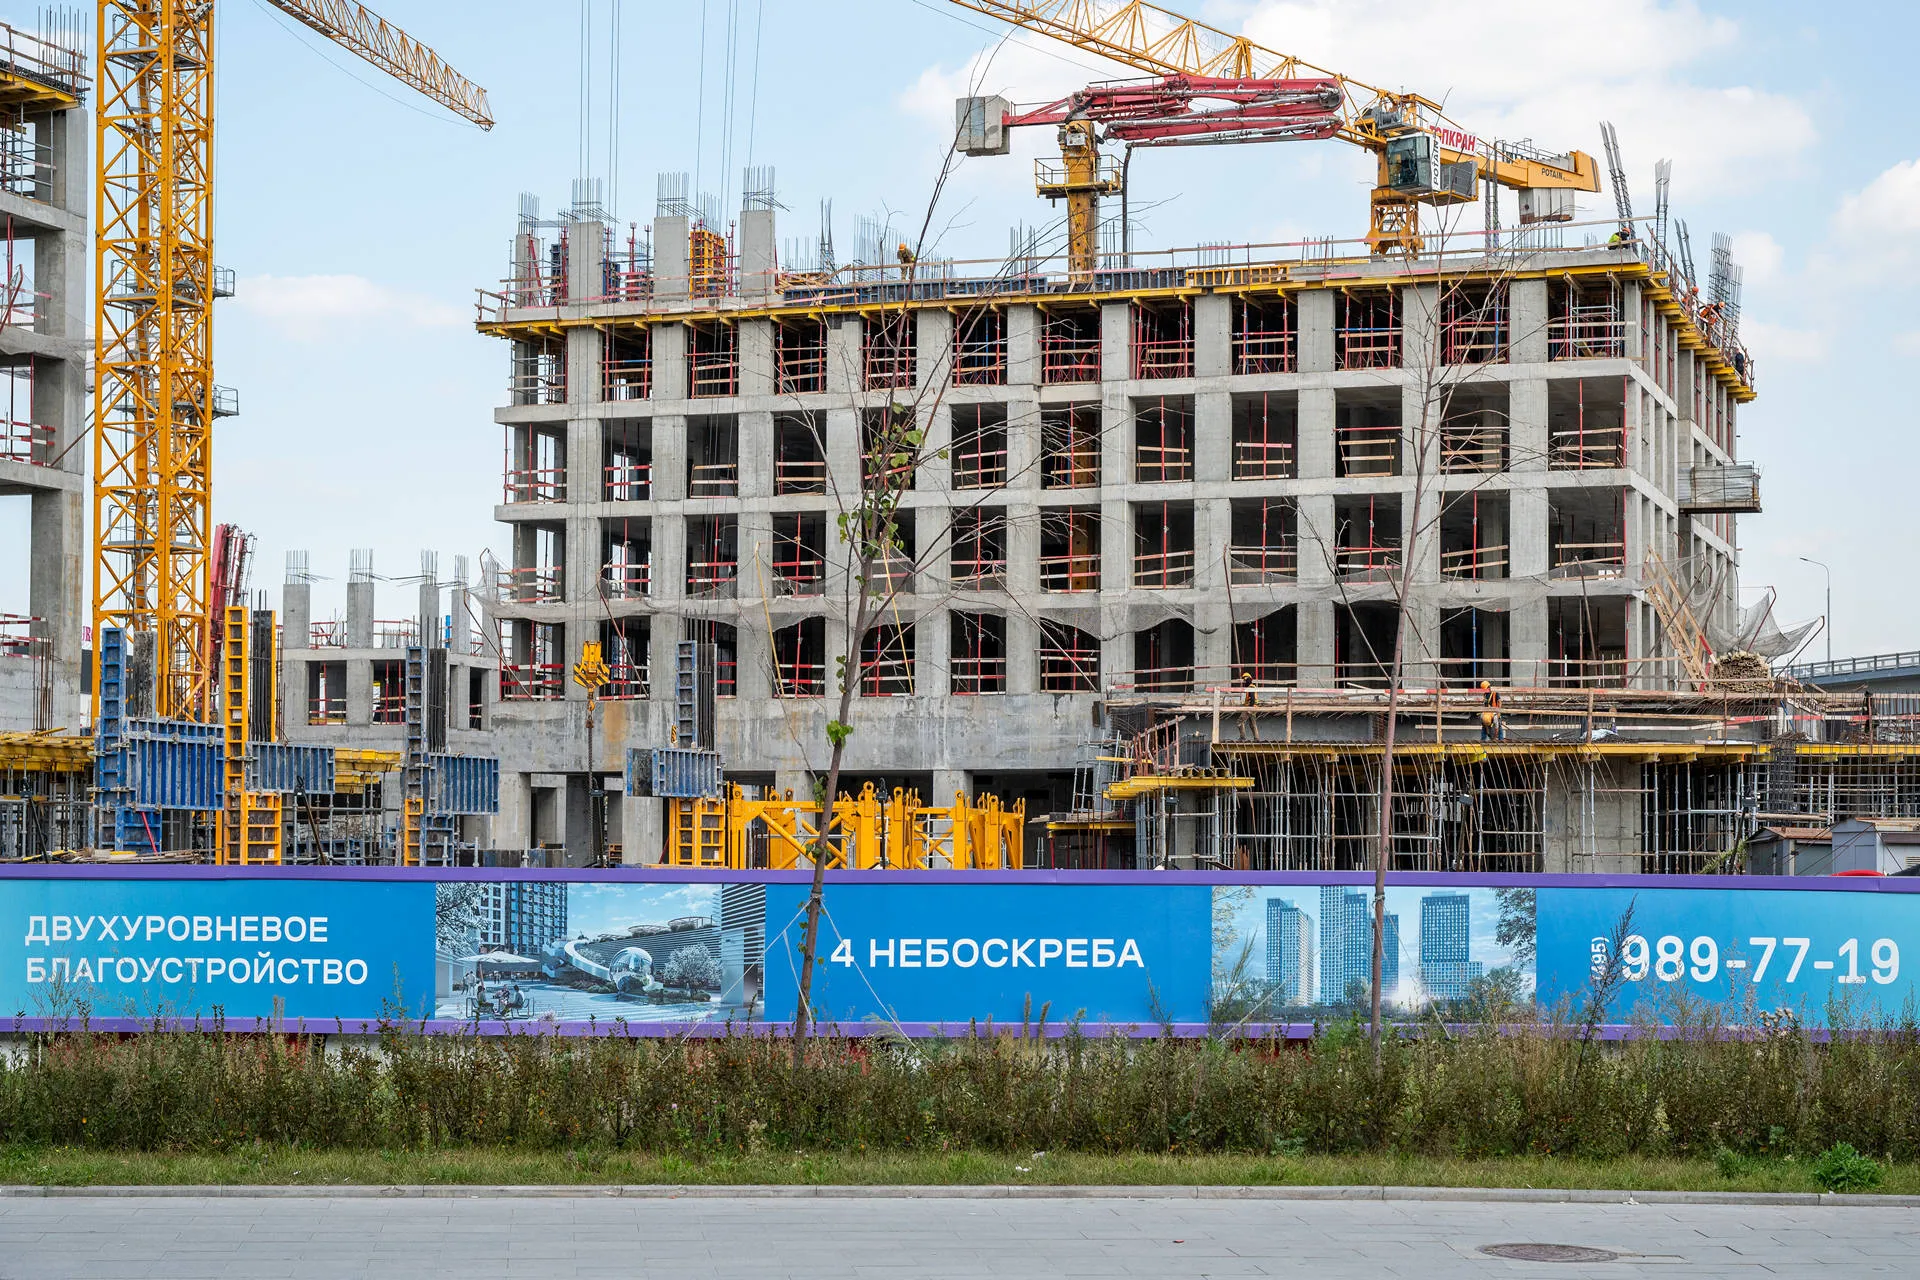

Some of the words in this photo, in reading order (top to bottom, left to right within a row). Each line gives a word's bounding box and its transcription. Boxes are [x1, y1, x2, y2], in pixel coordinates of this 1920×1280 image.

[1541, 167, 1563, 180] POTAIN
[25, 916, 328, 946] ДВУХУРОВНЕВОЕ
[26, 951, 368, 984] БЛАГОУСТРОЙСТВО
[831, 939, 855, 967] 4
[870, 938, 1144, 968] НЕБОСКРЕБА
[1621, 935, 1900, 985] 989-77-19
